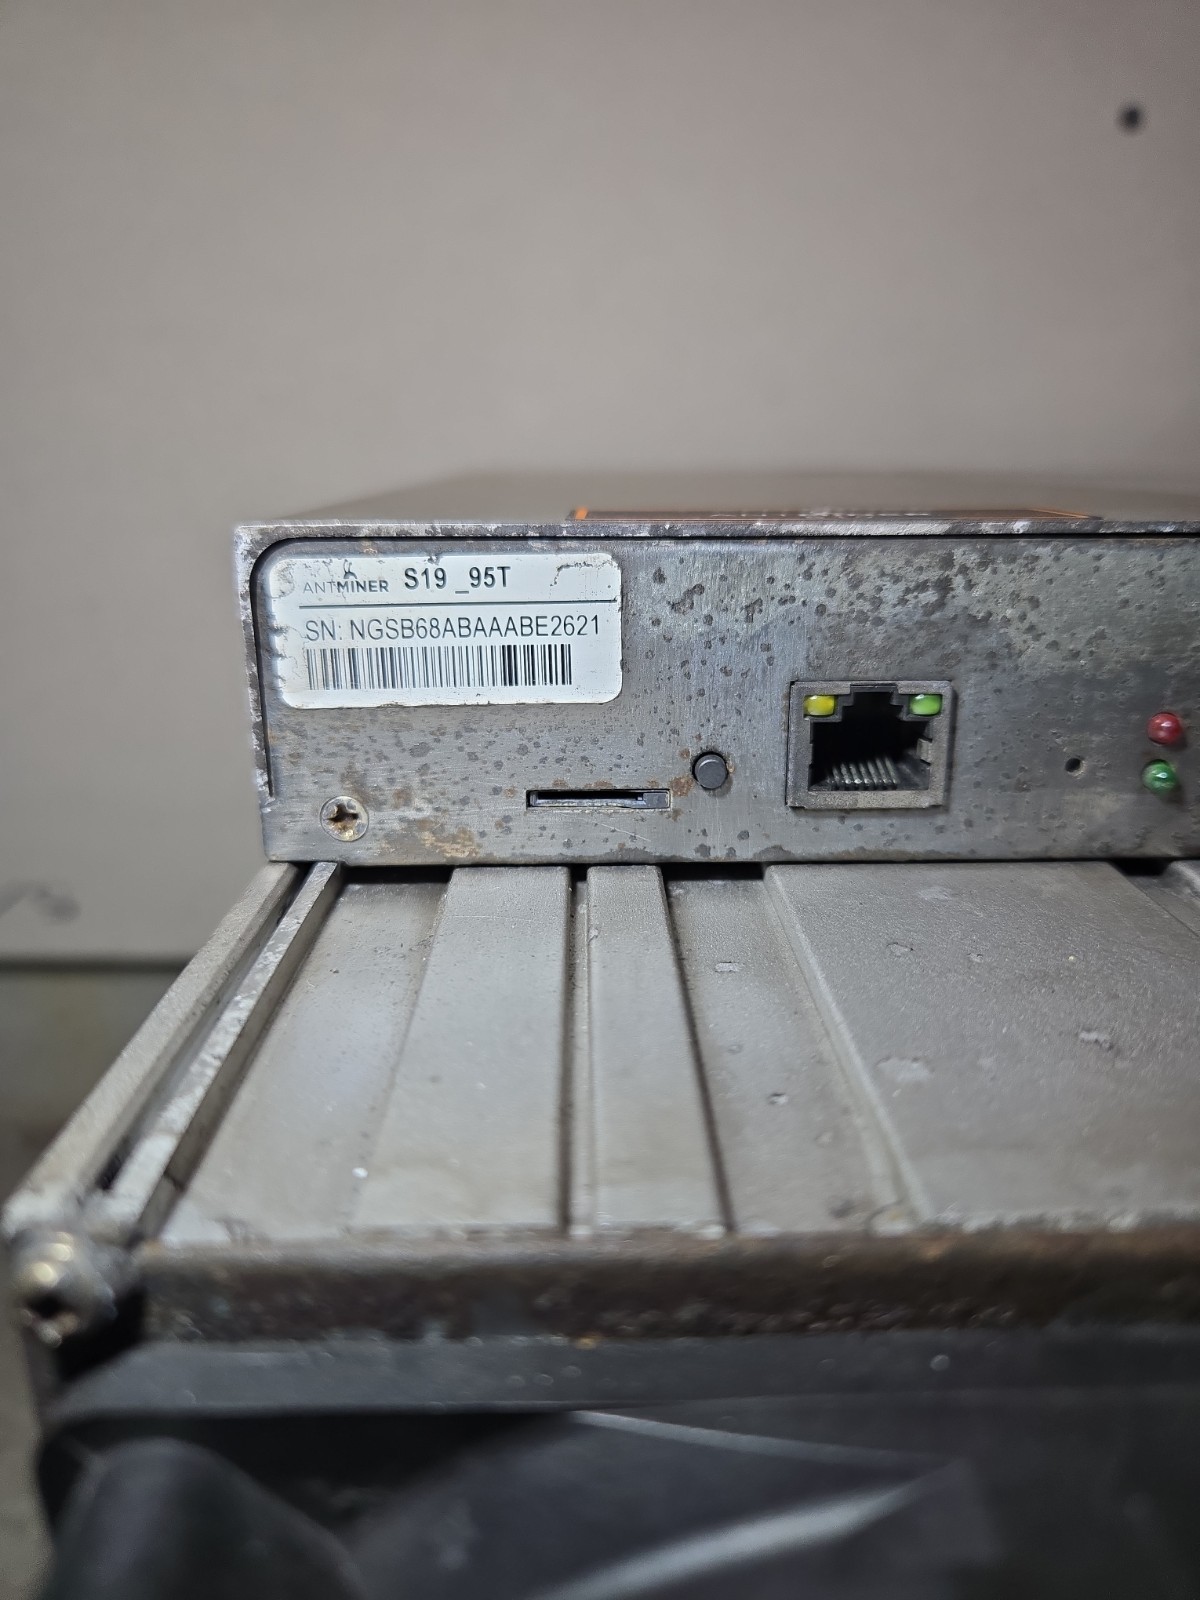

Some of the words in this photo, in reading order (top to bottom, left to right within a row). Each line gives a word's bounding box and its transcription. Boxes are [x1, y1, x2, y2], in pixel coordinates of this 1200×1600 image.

[303, 579, 390, 594] ANTMINER
[404, 567, 447, 590] S19
[454, 565, 511, 594] _95T
[305, 619, 343, 642] SN:
[350, 614, 599, 641] NGSB68ABAAABE2621
